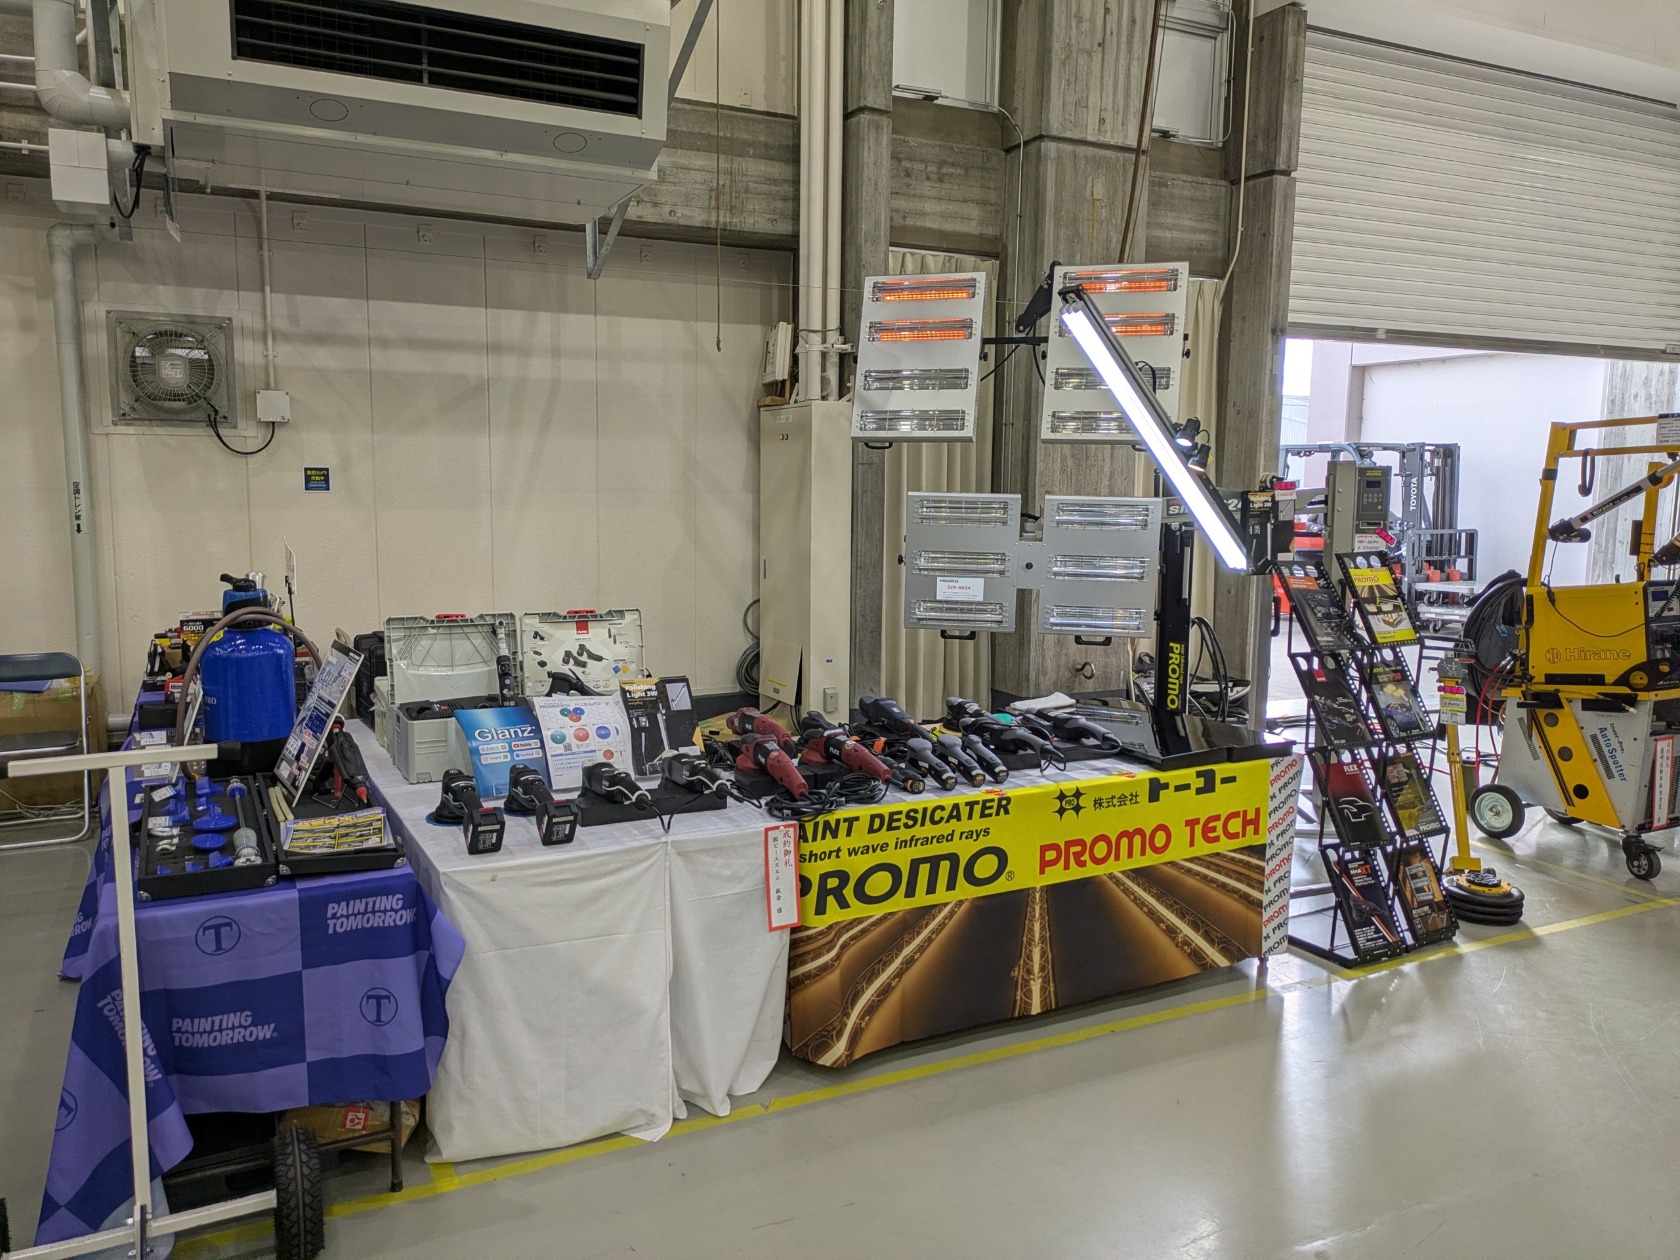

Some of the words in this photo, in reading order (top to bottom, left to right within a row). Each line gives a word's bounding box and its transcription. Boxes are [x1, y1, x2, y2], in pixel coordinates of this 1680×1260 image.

[1410, 477, 1418, 512] TOYOTA
[1592, 502, 1614, 516] Hirane
[1353, 575, 1380, 583] PROMO
[1565, 647, 1631, 661] Hirane
[624, 683, 657, 691] Polishing
[1167, 642, 1181, 709] PROMO
[474, 727, 535, 741] Glanz
[1343, 764, 1359, 772] FLEX
[1598, 727, 1627, 782] AutoSpotter
[1270, 759, 1298, 787] PROMO
[1064, 797, 1076, 808] PRO
[1092, 791, 1140, 811] 株式会社
[1148, 768, 1237, 804] トーコー
[867, 796, 1013, 835] DESICATER
[1268, 789, 1297, 819] PROMO
[1267, 806, 1295, 835] PROMO
[1420, 821, 1441, 832] PROMO
[783, 829, 793, 868] 成約御礼
[799, 846, 842, 864] short
[847, 842, 889, 859] wave
[894, 828, 955, 850] infrared
[959, 827, 991, 843] rays
[1039, 823, 1172, 876] PROMO
[1184, 806, 1261, 848] TECH
[1266, 836, 1295, 866] PROMO
[1265, 853, 1293, 881] PROMO
[326, 893, 404, 919] PAINTING
[327, 907, 417, 934] TOMORROW
[171, 1010, 253, 1033] PAINTING
[172, 1023, 276, 1048] TOMORROW
